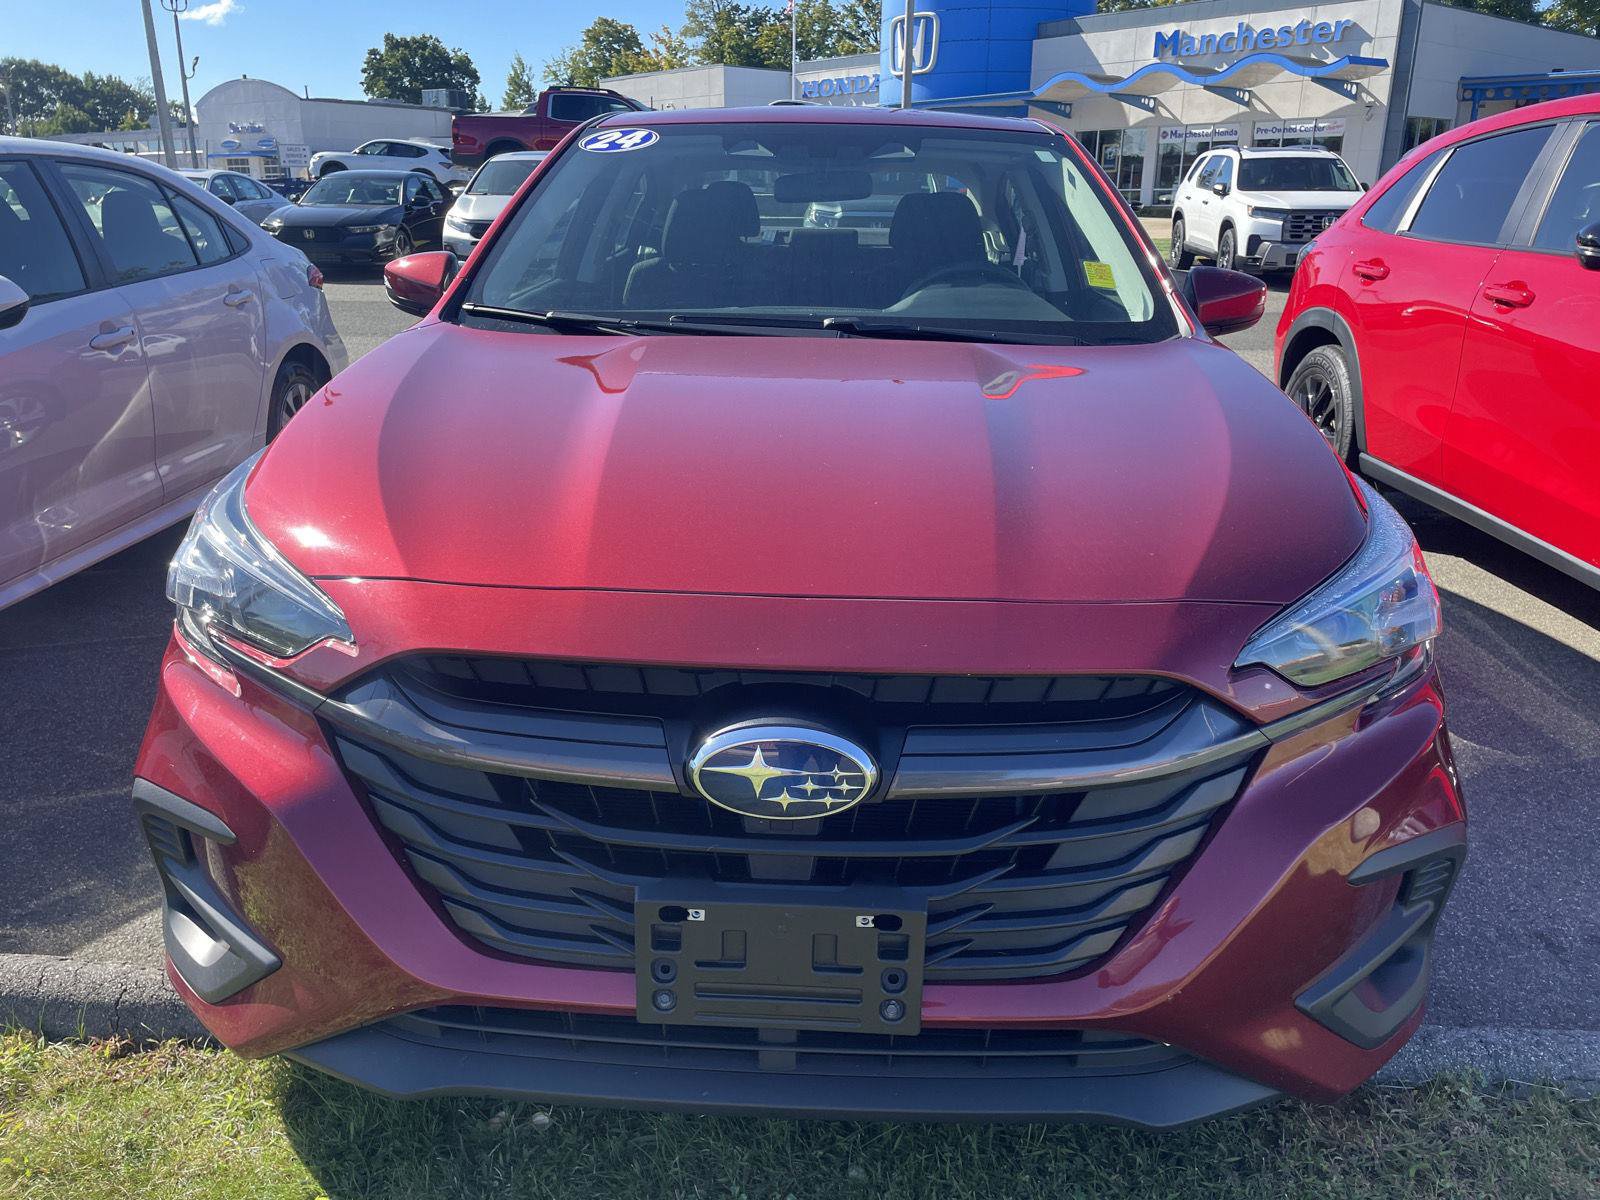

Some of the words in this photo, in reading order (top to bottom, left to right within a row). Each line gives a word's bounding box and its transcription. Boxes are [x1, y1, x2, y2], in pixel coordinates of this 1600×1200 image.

[1153, 18, 1354, 58] Manchester
[586, 130, 650, 149] 24
[1214, 128, 1238, 137] Honda
